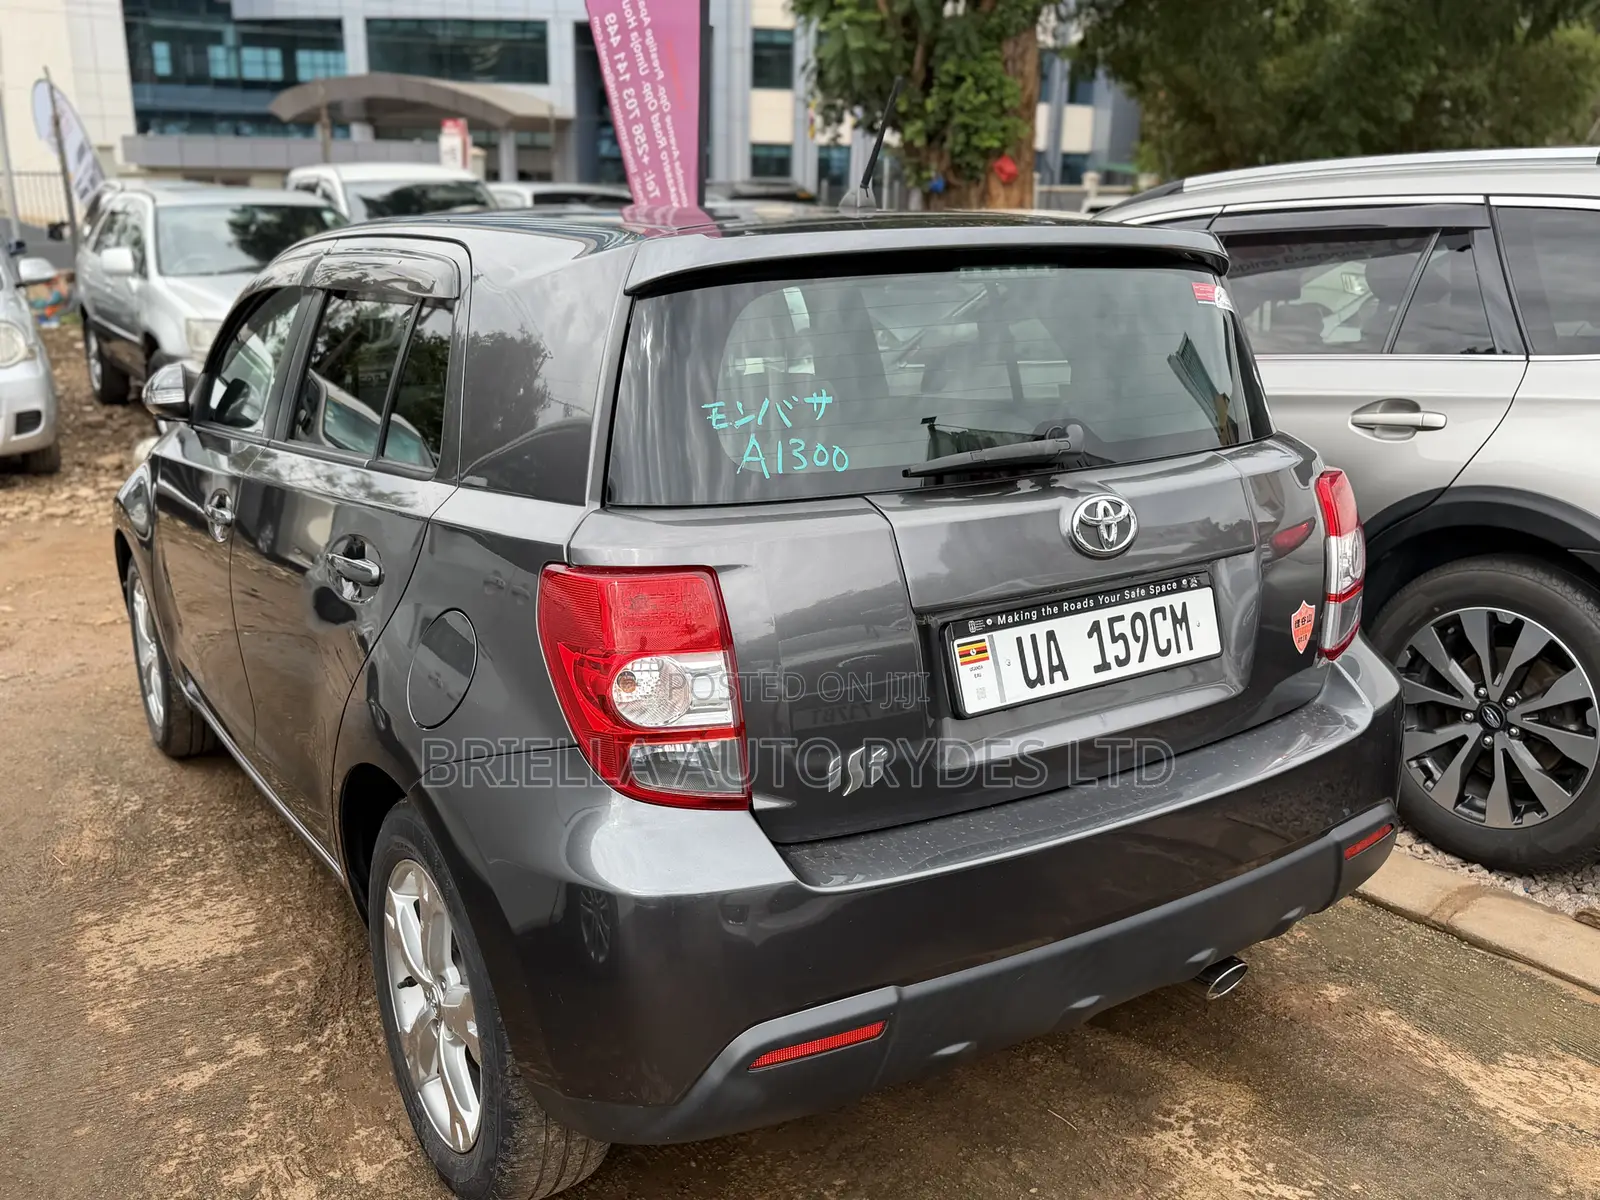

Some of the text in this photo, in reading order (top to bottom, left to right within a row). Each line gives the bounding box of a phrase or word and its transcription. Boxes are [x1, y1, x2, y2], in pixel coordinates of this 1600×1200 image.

[701, 389, 833, 430] モンバサ
[736, 432, 849, 479] A1300
[997, 610, 1038, 626] Making
[1041, 603, 1059, 616] the
[1062, 598, 1095, 612] Roads
[1098, 594, 1121, 605] Your
[1124, 587, 1146, 600] Safe
[1149, 582, 1178, 597] Space
[1016, 601, 1194, 689] UA 159CM
